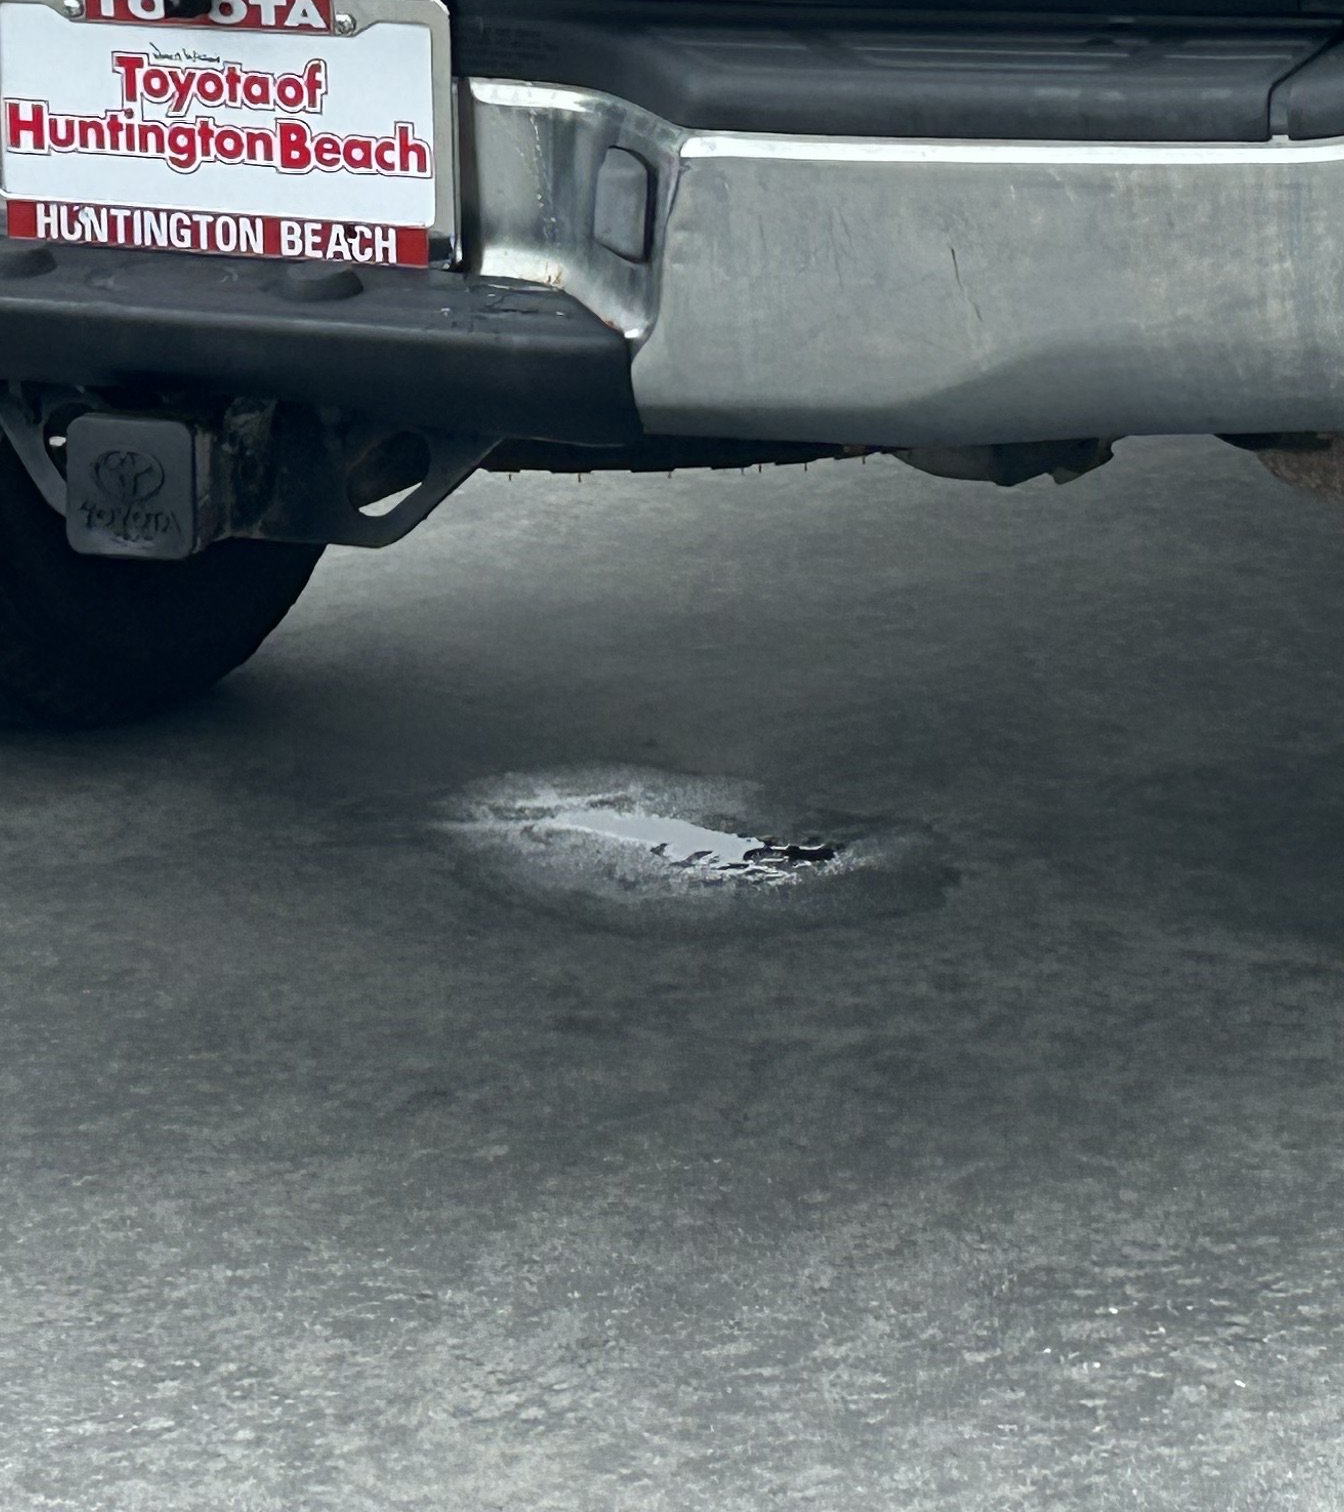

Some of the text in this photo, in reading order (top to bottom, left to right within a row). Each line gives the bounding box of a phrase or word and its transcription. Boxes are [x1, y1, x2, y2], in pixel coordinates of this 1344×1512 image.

[112, 54, 271, 112] Toyota
[7, 101, 429, 175] Huntington Beach
[36, 203, 397, 264] HUNTINGTON BEACH
